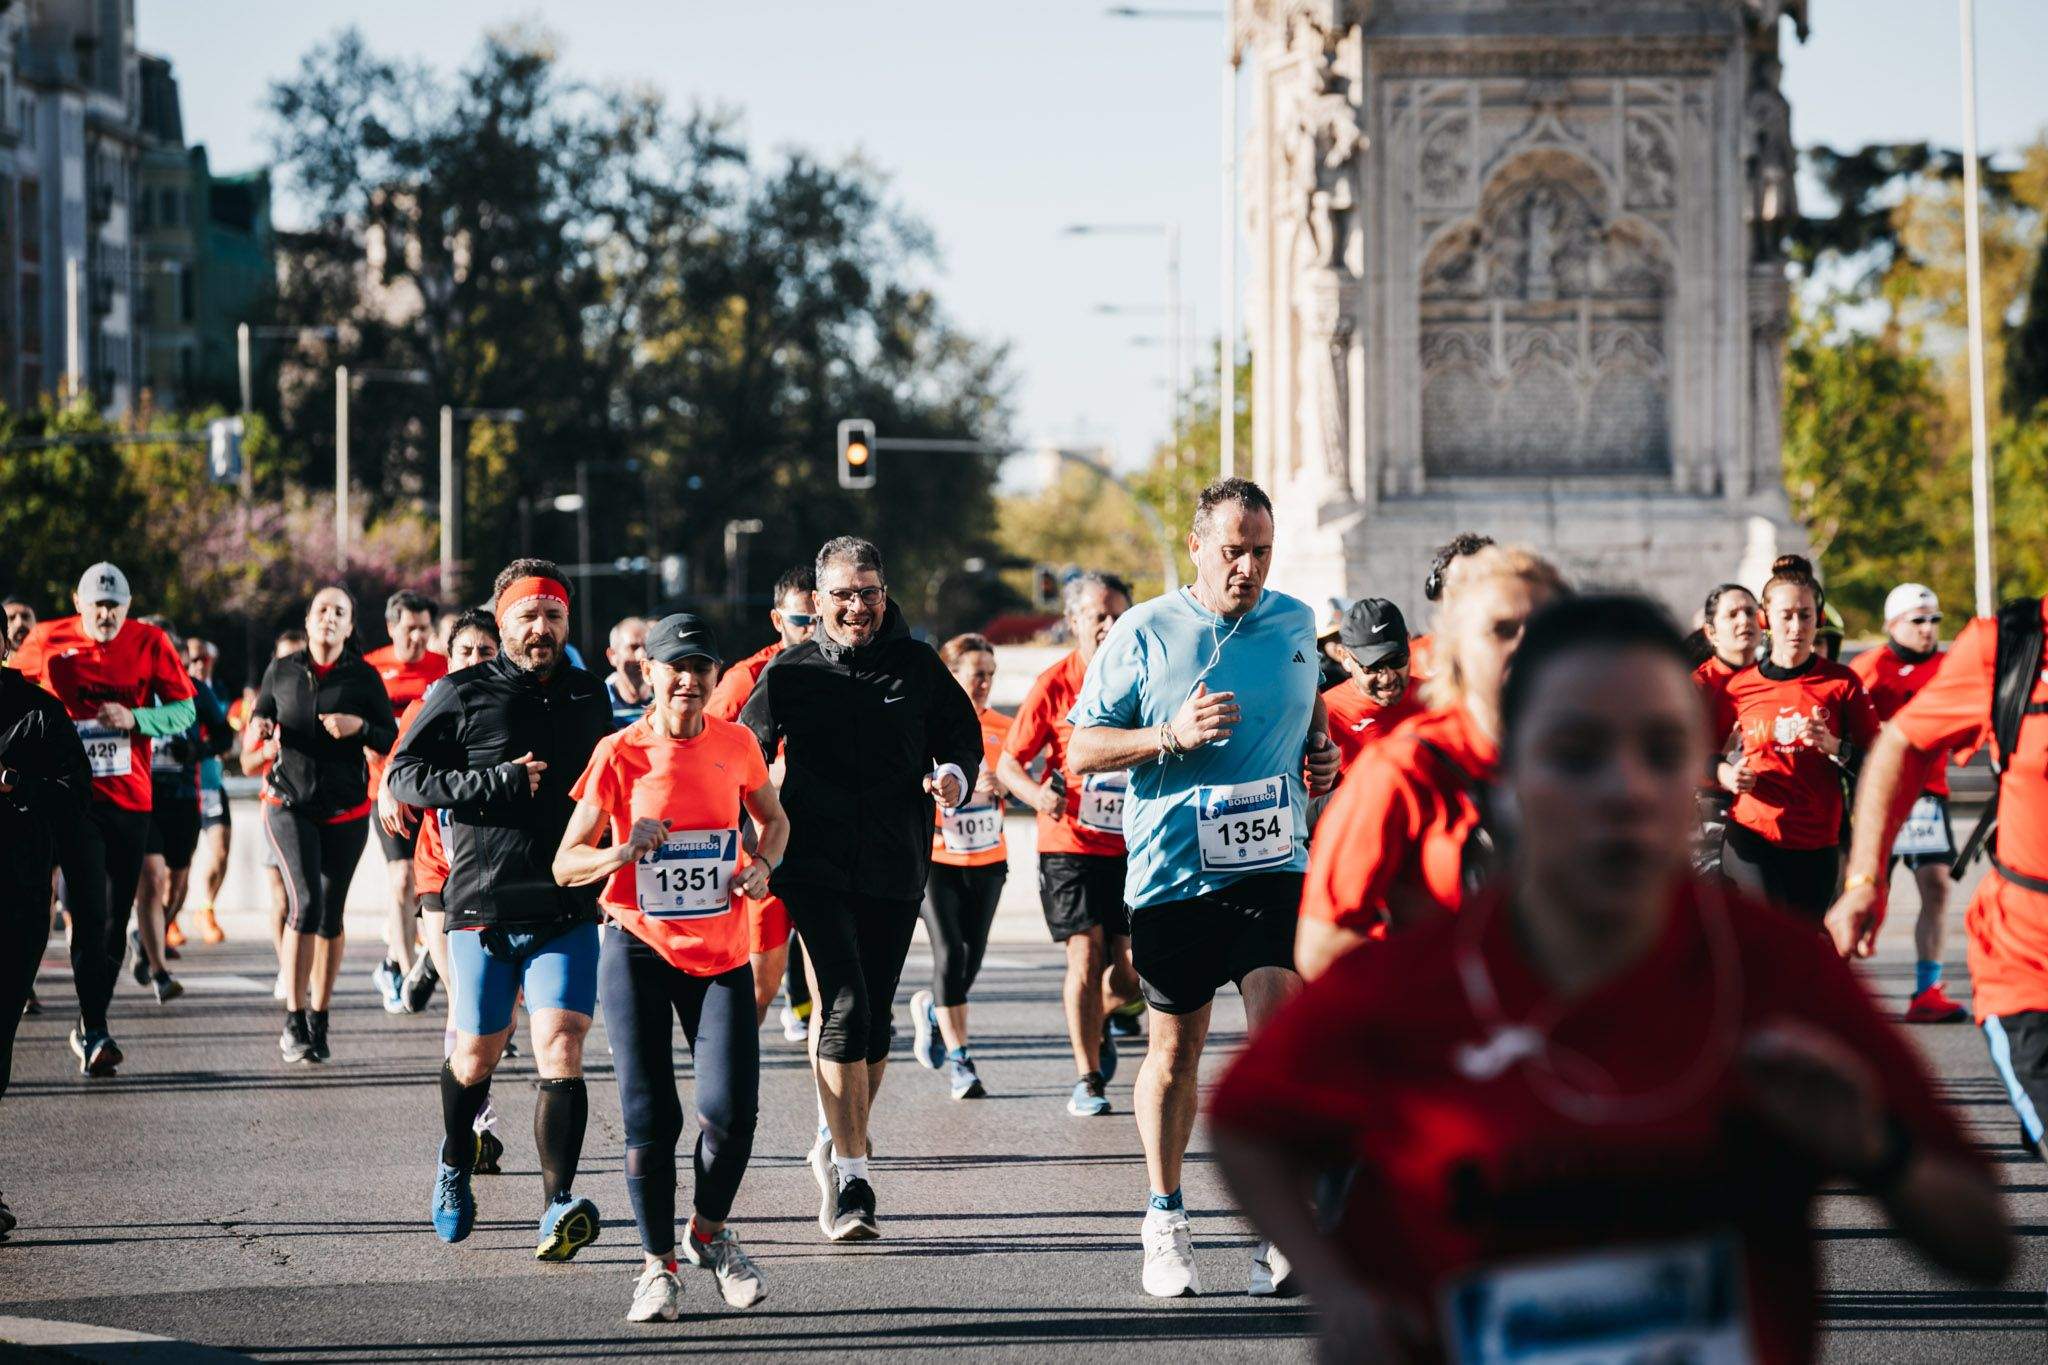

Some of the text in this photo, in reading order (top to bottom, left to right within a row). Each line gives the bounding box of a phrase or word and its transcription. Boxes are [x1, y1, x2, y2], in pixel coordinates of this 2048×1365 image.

[87, 742, 117, 758] 429
[1095, 798, 1124, 814] 147
[1228, 792, 1276, 807] BOMBEROS
[957, 817, 993, 835] 1013
[1218, 815, 1281, 846] 1354
[668, 842, 719, 852] BOMBEROS
[656, 867, 718, 892] 1351
